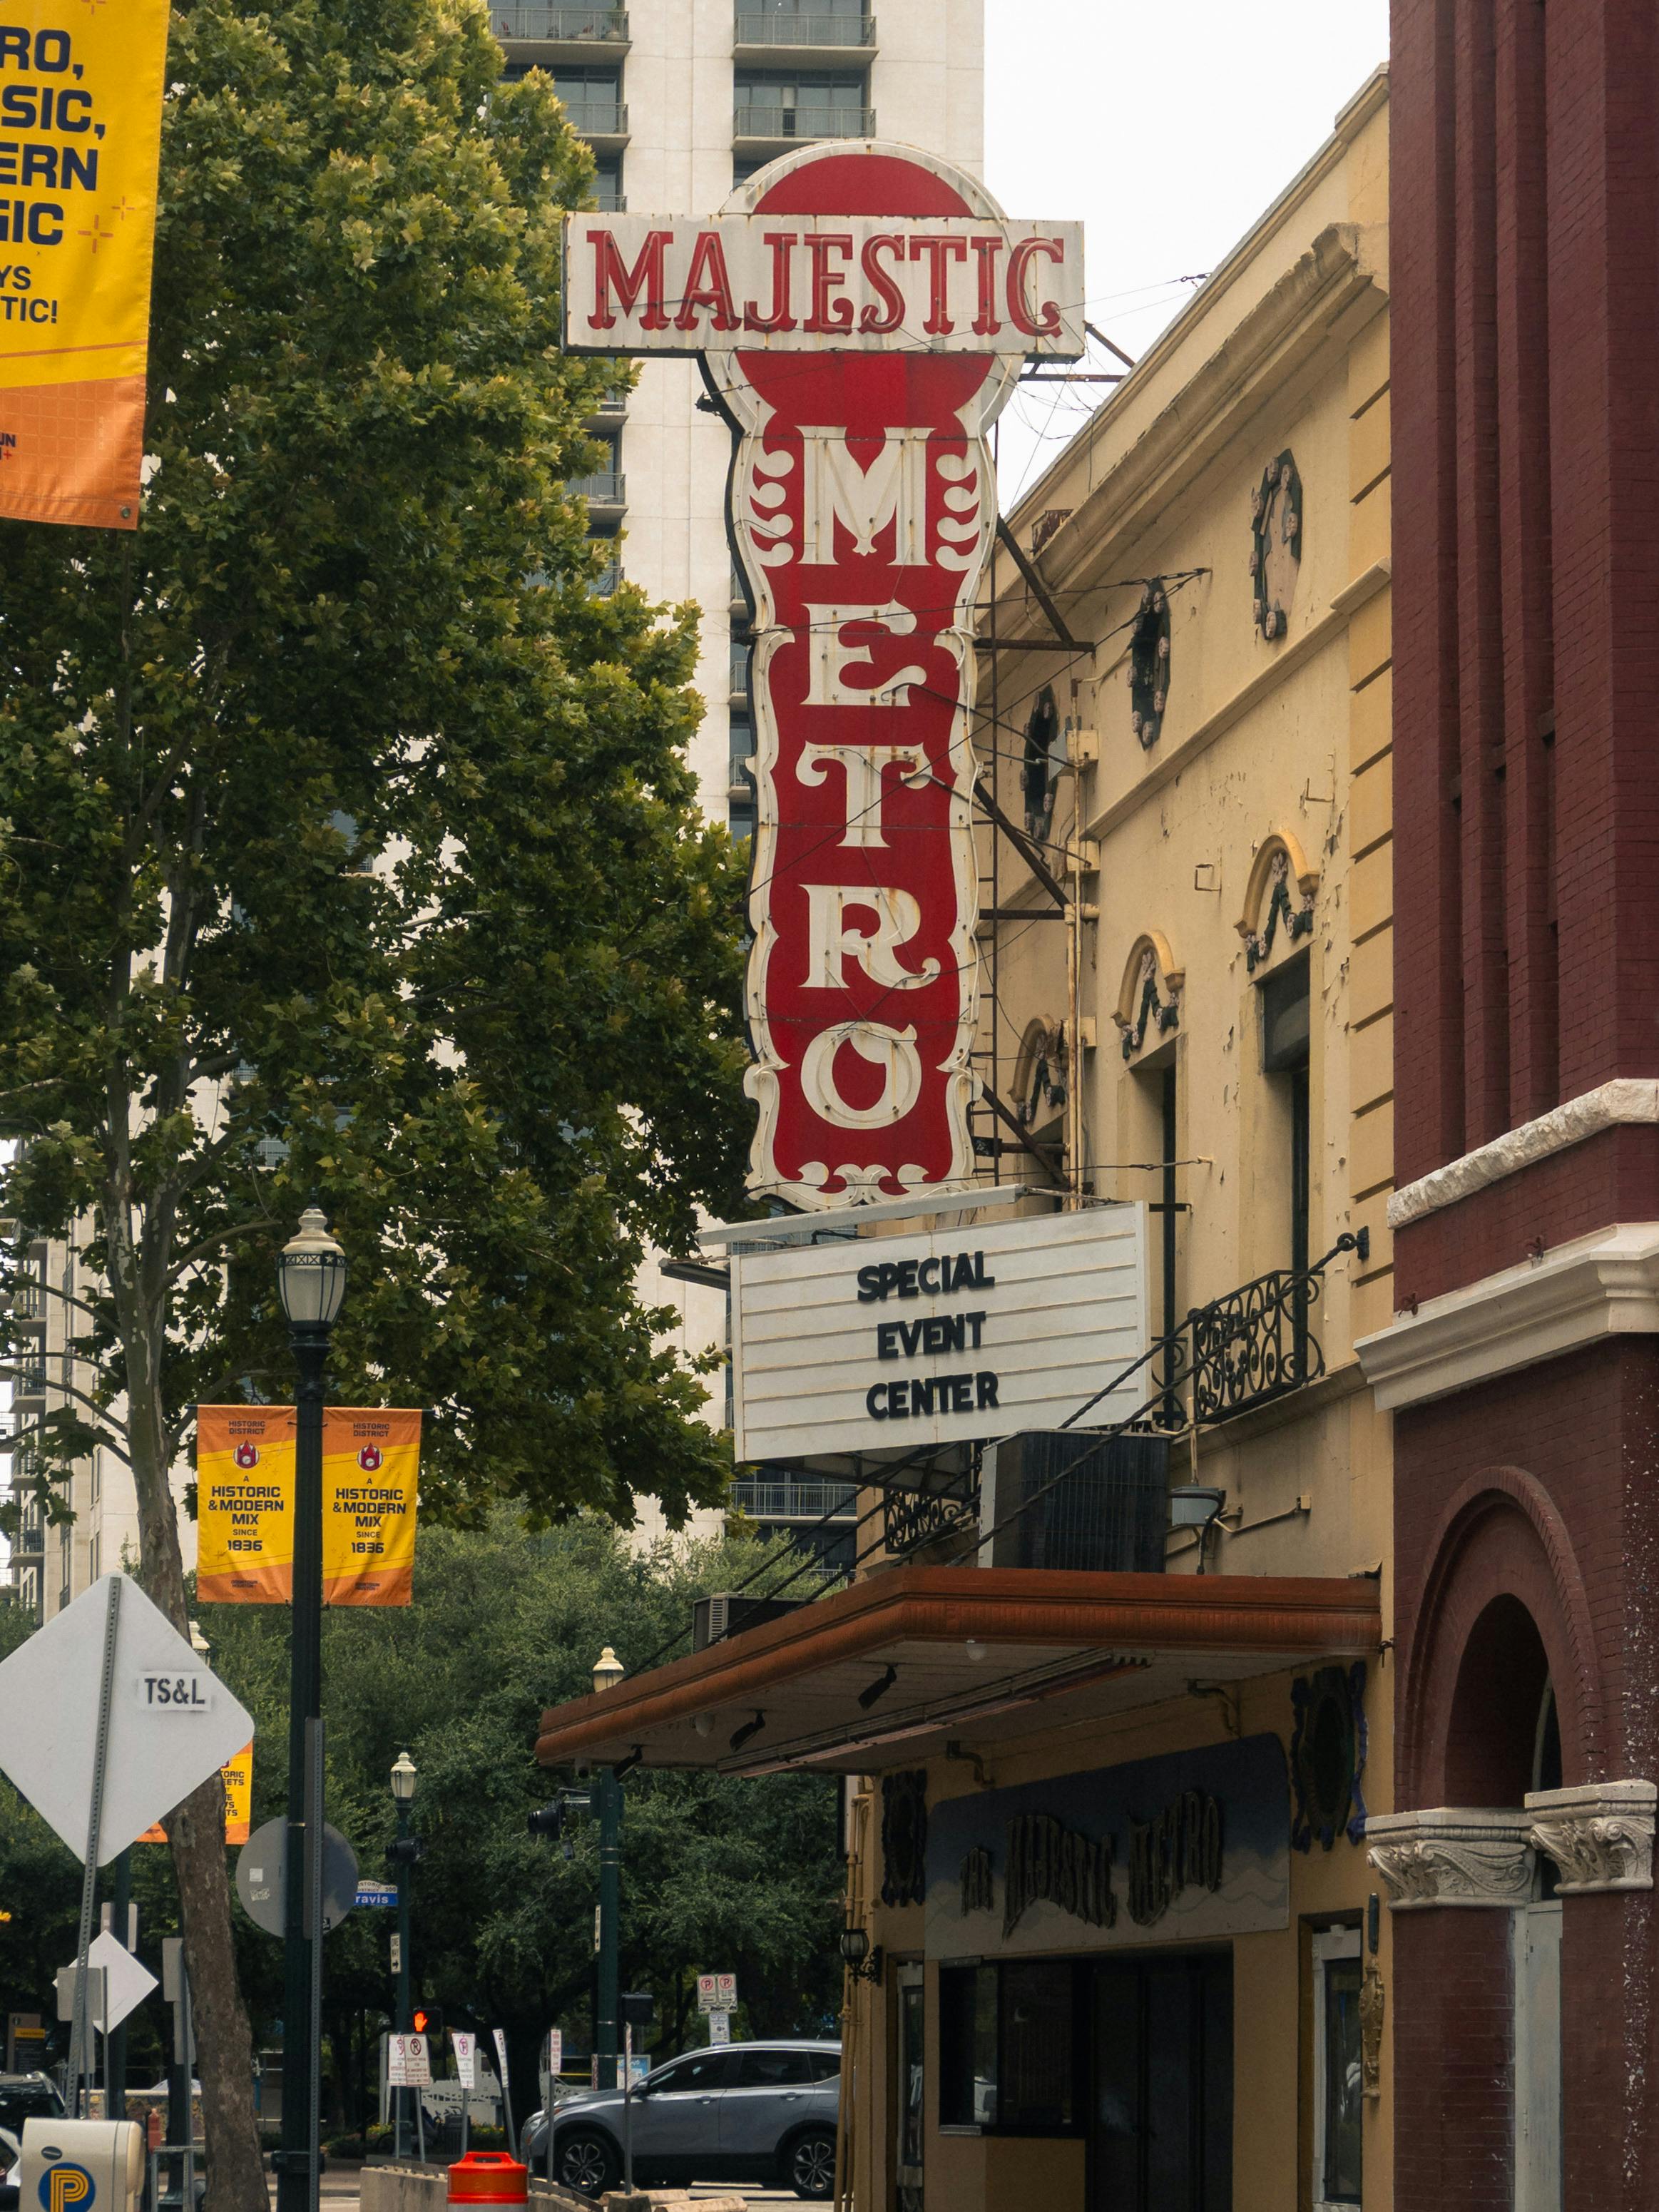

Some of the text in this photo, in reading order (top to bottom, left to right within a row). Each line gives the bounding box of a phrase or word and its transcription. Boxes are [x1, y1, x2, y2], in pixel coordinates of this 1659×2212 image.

[0, 25, 83, 81] RO,
[1, 84, 106, 141] SIC,
[0, 199, 64, 246] IC
[586, 229, 1064, 338] MAJESTIC
[0, 295, 57, 324] TIC!
[794, 424, 941, 1130] METRO
[857, 1250, 996, 1303] SPECIAL
[877, 1310, 987, 1360] EVENT
[866, 1371, 1000, 1420] CENTER
[211, 1486, 281, 1498] HISTORIC
[220, 1499, 285, 1512] MODERN
[335, 1488, 404, 1501] HISTORIC
[231, 1513, 259, 1525] MIX
[344, 1502, 407, 1514] MODERN
[355, 1516, 382, 1527] MIX
[228, 1539, 263, 1551] 1836
[351, 1542, 385, 1554] 1836
[144, 1677, 205, 1706] TS&L
